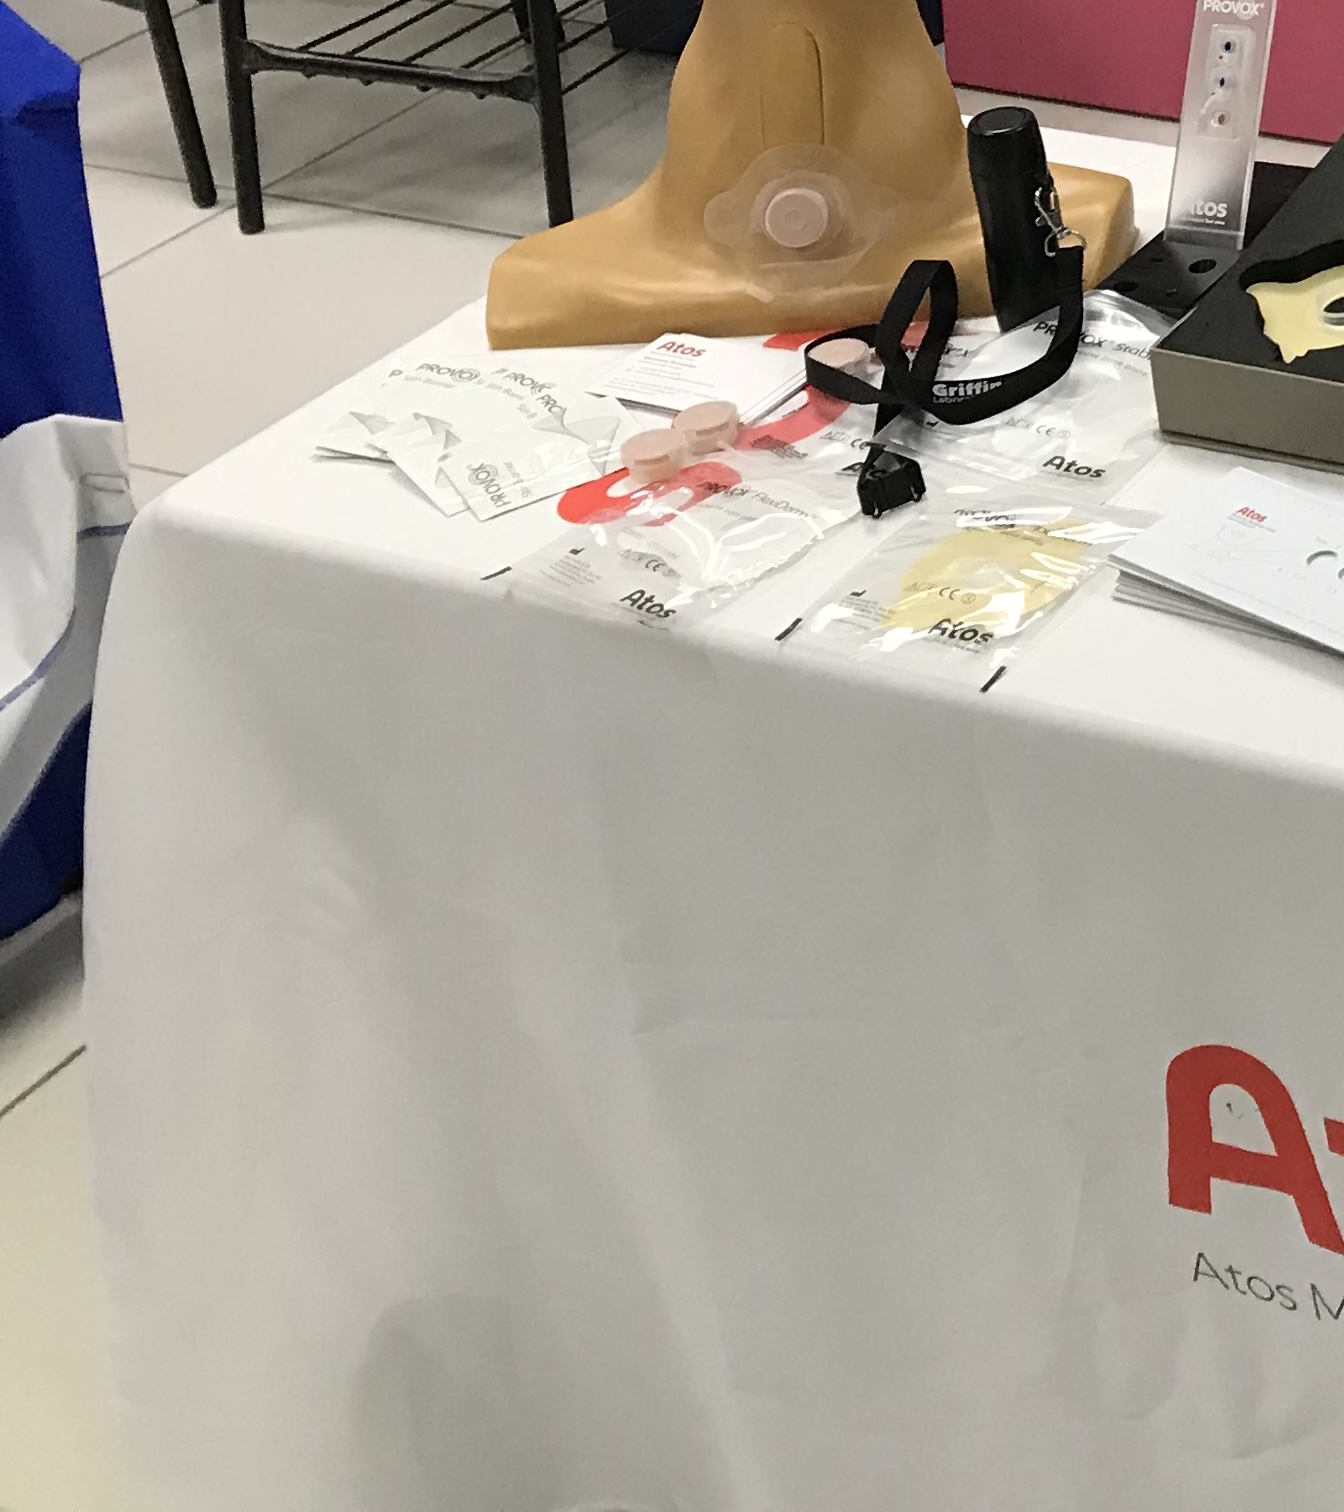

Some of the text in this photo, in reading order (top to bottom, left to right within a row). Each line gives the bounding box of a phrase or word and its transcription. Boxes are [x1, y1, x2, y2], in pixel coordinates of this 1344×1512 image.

[656, 341, 707, 358] Atos
[1042, 455, 1106, 479] Atos
[1236, 506, 1268, 523] Atos
[619, 589, 677, 619] Atos
[928, 617, 995, 645] Atos
[1192, 1251, 1298, 1312] Atos
